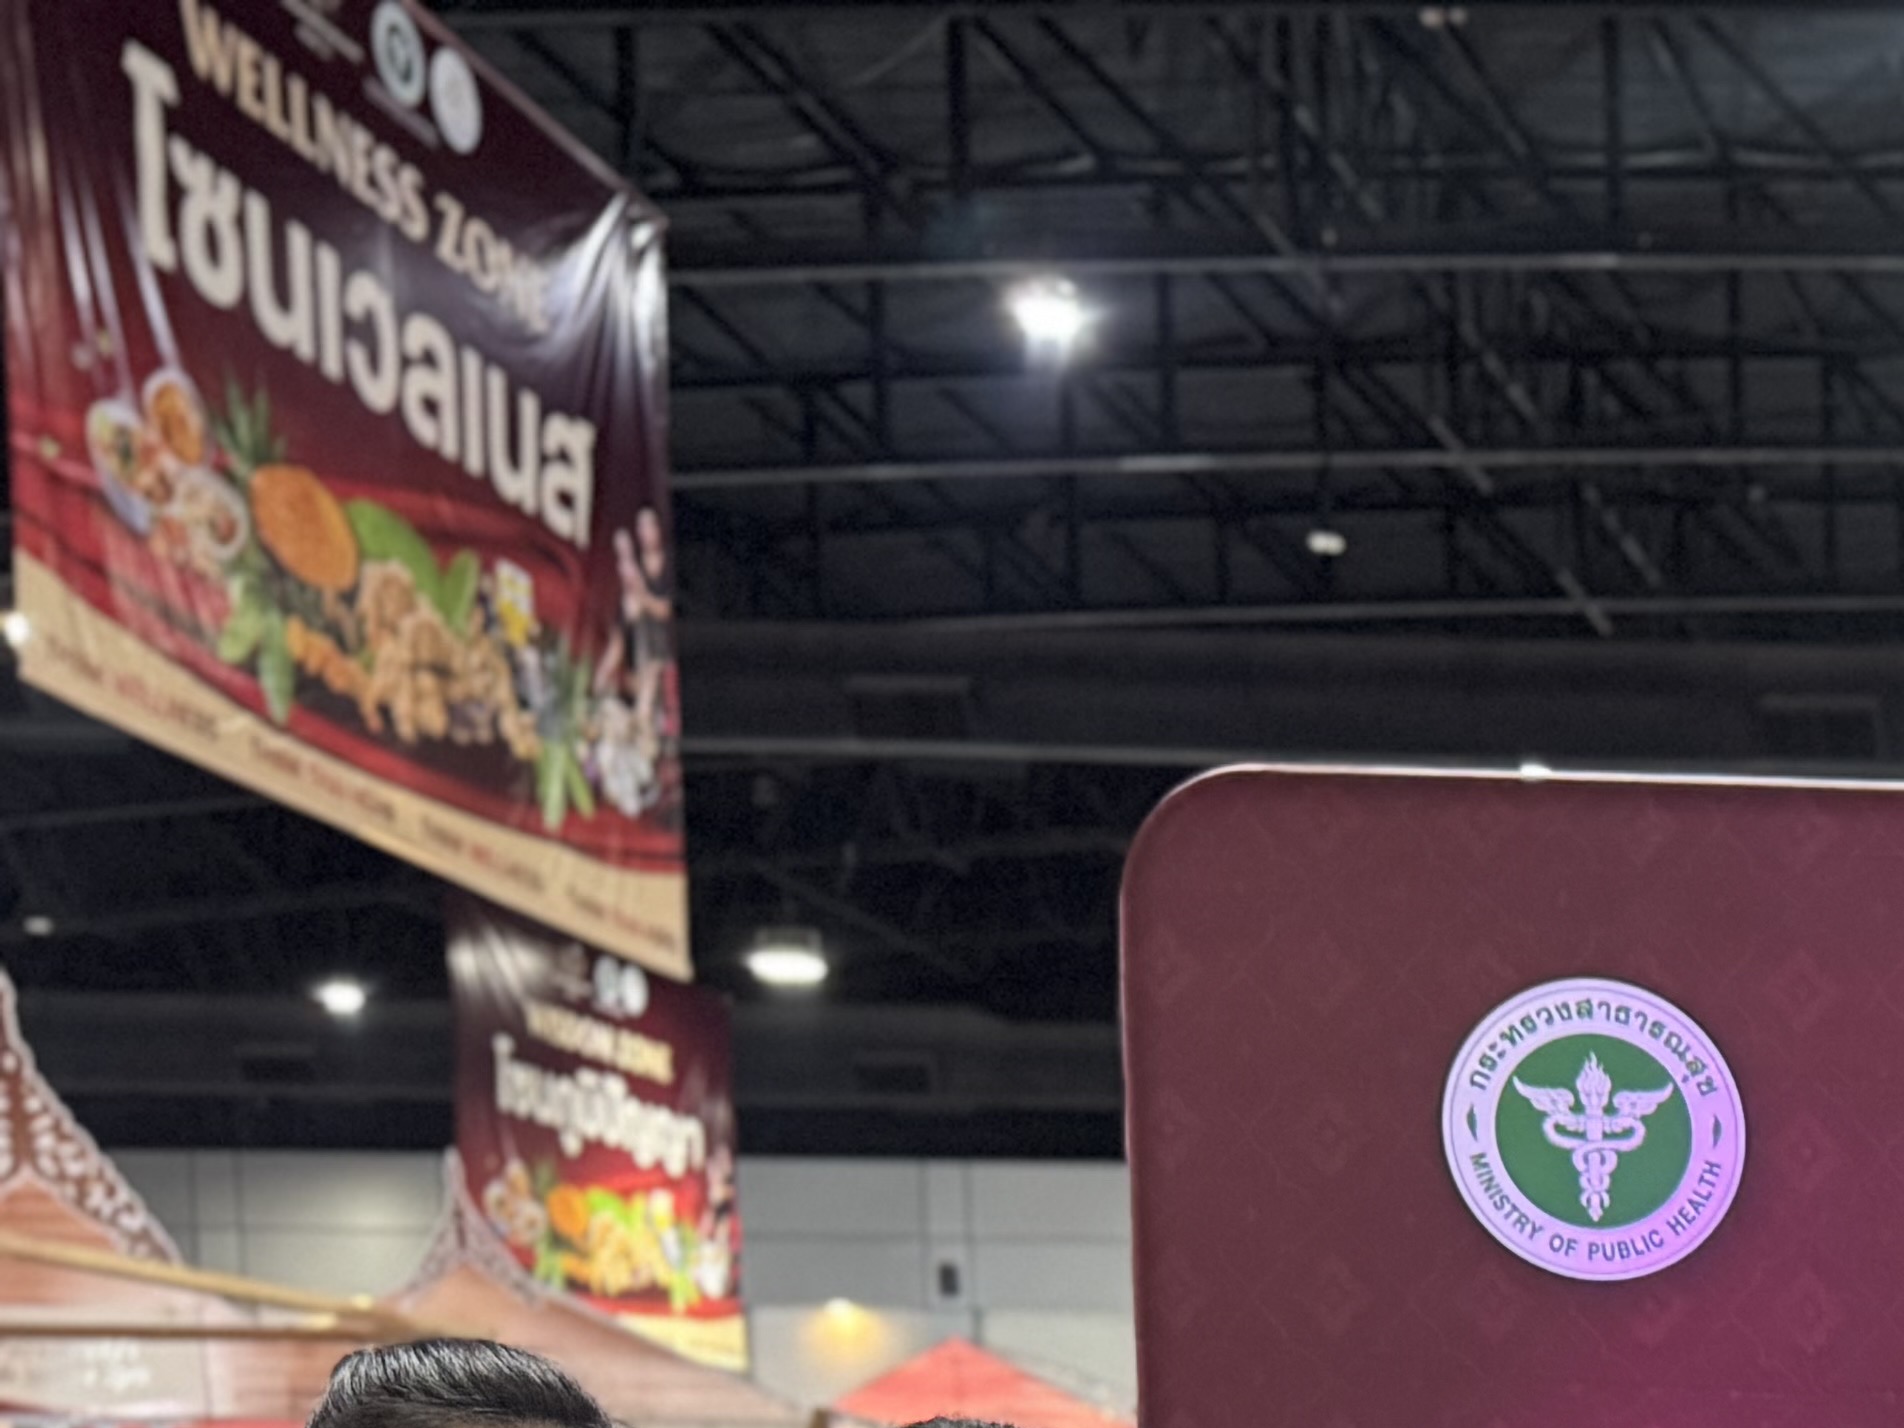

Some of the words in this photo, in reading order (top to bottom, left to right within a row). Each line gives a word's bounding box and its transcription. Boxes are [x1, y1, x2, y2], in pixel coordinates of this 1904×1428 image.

[180, 0, 429, 242] WELLNESS
[122, 39, 598, 547] โซนเวลเนส
[1469, 997, 1718, 1097] กระทรวงสาธารณสุข
[1470, 1152, 1544, 1241] MINISTRY
[1549, 1233, 1578, 1257] OF
[1588, 1229, 1665, 1262] PUBLIC
[1666, 1160, 1722, 1237] HEALTH
